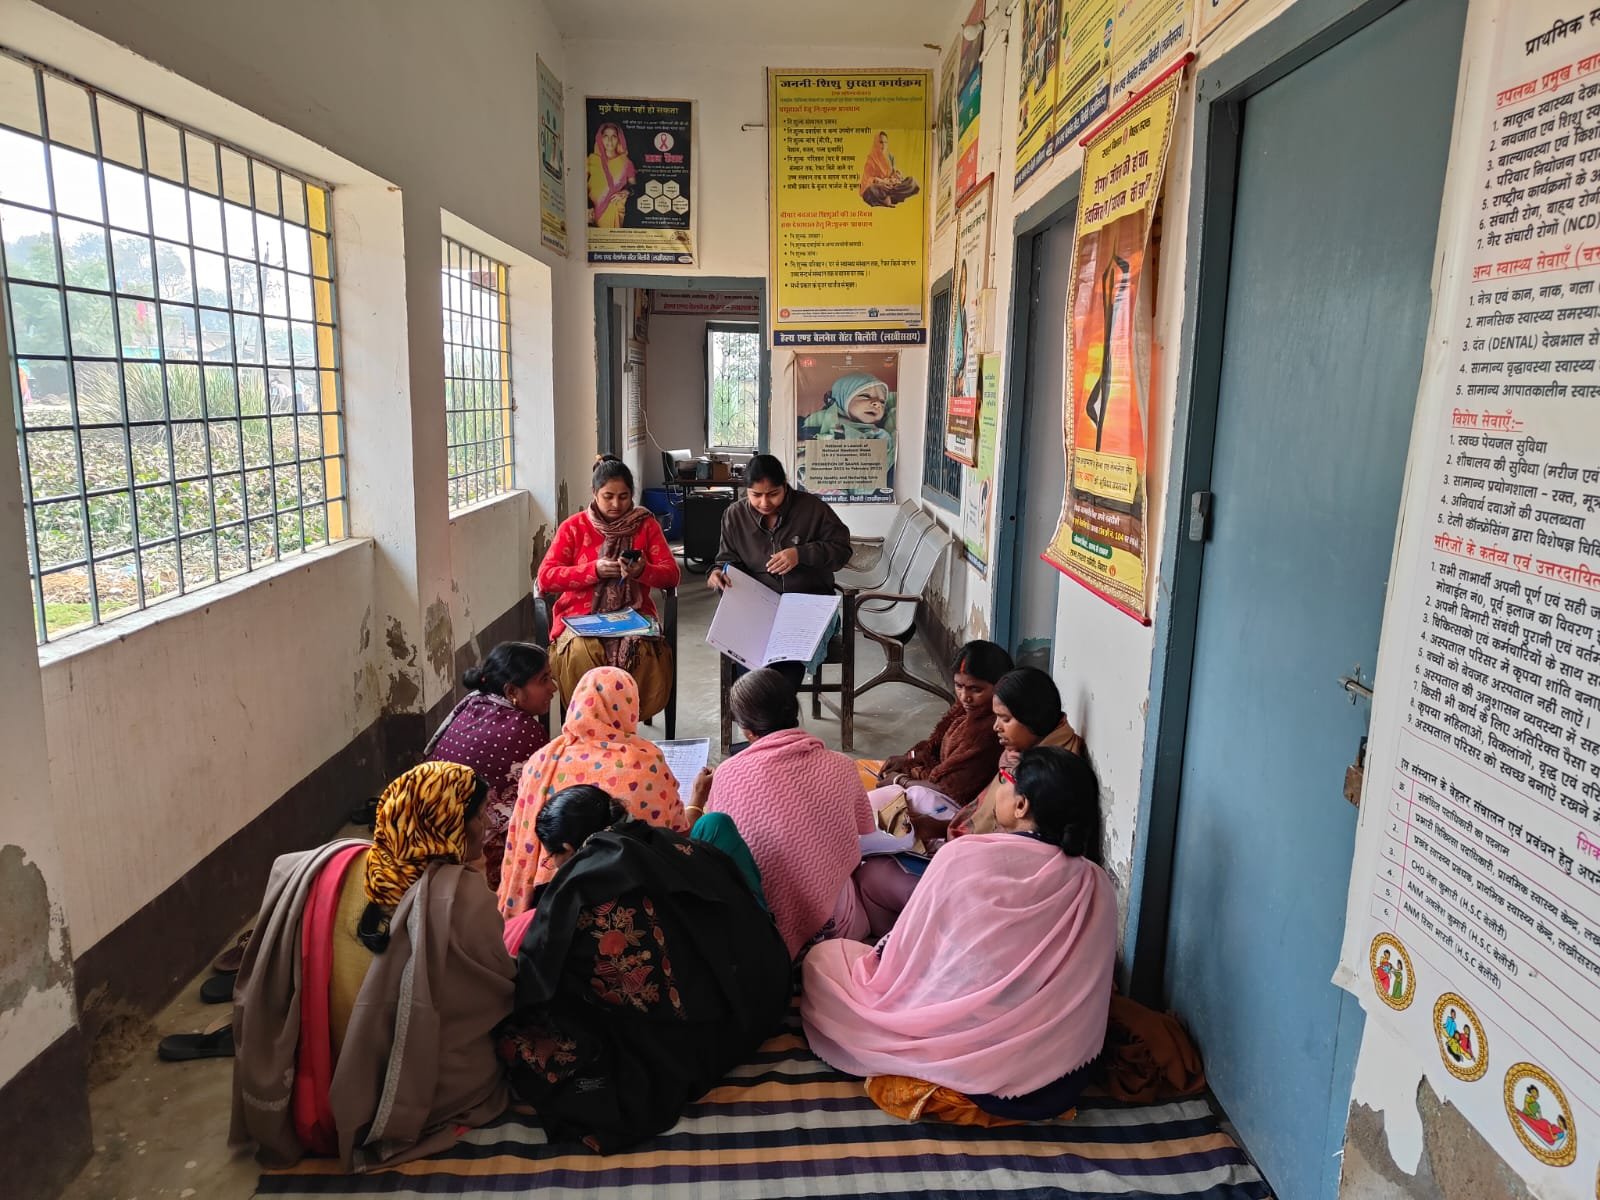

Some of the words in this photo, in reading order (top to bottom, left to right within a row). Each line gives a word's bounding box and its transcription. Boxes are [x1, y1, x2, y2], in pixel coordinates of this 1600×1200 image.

[1525, 15, 1584, 56] प्राथमिक
[1542, 64, 1573, 92] प्रमुख
[1501, 126, 1538, 147] नवजात
[1540, 115, 1555, 137] एवं
[1554, 131, 1570, 152] एवं
[1497, 167, 1531, 187] परिवार
[1533, 154, 1576, 178] नियोजन
[1486, 230, 1502, 247] गैर
[1504, 223, 1534, 245] संचारी
[1495, 287, 1509, 305] एवं
[1476, 310, 1515, 327] मानसिक
[1488, 334, 1538, 353] (DENTAL)
[1542, 330, 1584, 348] देखभाल
[1471, 361, 1504, 375] सामान्य
[1467, 384, 1500, 397] सामान्य
[1502, 380, 1568, 398] आपातकालीन
[1452, 407, 1478, 427] विशेष
[1458, 435, 1480, 447] स्वच्छ
[1481, 432, 1513, 451] पेयजल
[1516, 436, 1548, 456] सुविधा
[1456, 451, 1491, 470] शौचालय
[1509, 457, 1540, 478] सुविधा
[1453, 475, 1485, 491] सामान्य
[1488, 477, 1538, 499] प्रयोगशाला
[1447, 511, 1464, 528] टेली
[1451, 492, 1486, 511] अनिवार्य
[1487, 500, 1516, 518] दवाओं
[1535, 509, 1586, 531] उपलब्धता
[1513, 553, 1533, 573] एवं
[1493, 580, 1522, 597] अपनी
[1524, 586, 1542, 605] पूर्ण
[1544, 592, 1561, 608] एवं
[1564, 598, 1587, 616] सही
[1434, 599, 1458, 617] अपनी
[1555, 639, 1573, 655] एवं
[1506, 602, 1535, 621] इलाज
[1556, 613, 1594, 640] विवरण
[1431, 633, 1466, 657] अस्पताल
[1469, 646, 1498, 669] परिसर
[1500, 657, 1510, 673] में
[1513, 665, 1542, 687] कृपया
[1545, 678, 1572, 698] शांति
[1476, 631, 1490, 646] एवं
[1560, 661, 1584, 681] साथ
[1491, 678, 1534, 705] अस्पताल
[1423, 668, 1459, 692] अस्पताल
[1475, 690, 1521, 720] अनुशासन
[1566, 727, 1577, 745] में
[1420, 680, 1442, 700] किसी
[1490, 715, 1511, 736] लिए
[1512, 728, 1560, 759] अतिरिक्त
[1563, 746, 1587, 772] पैसा
[1414, 718, 1451, 744] अस्पताल
[1454, 735, 1482, 761] परिसर
[1417, 700, 1441, 721] कृपया
[1561, 772, 1578, 790] एवं
[1508, 824, 1524, 838] एवं
[1411, 860, 1425, 876] CHO
[1407, 880, 1424, 899] ANM
[1403, 901, 1420, 920] ANM
